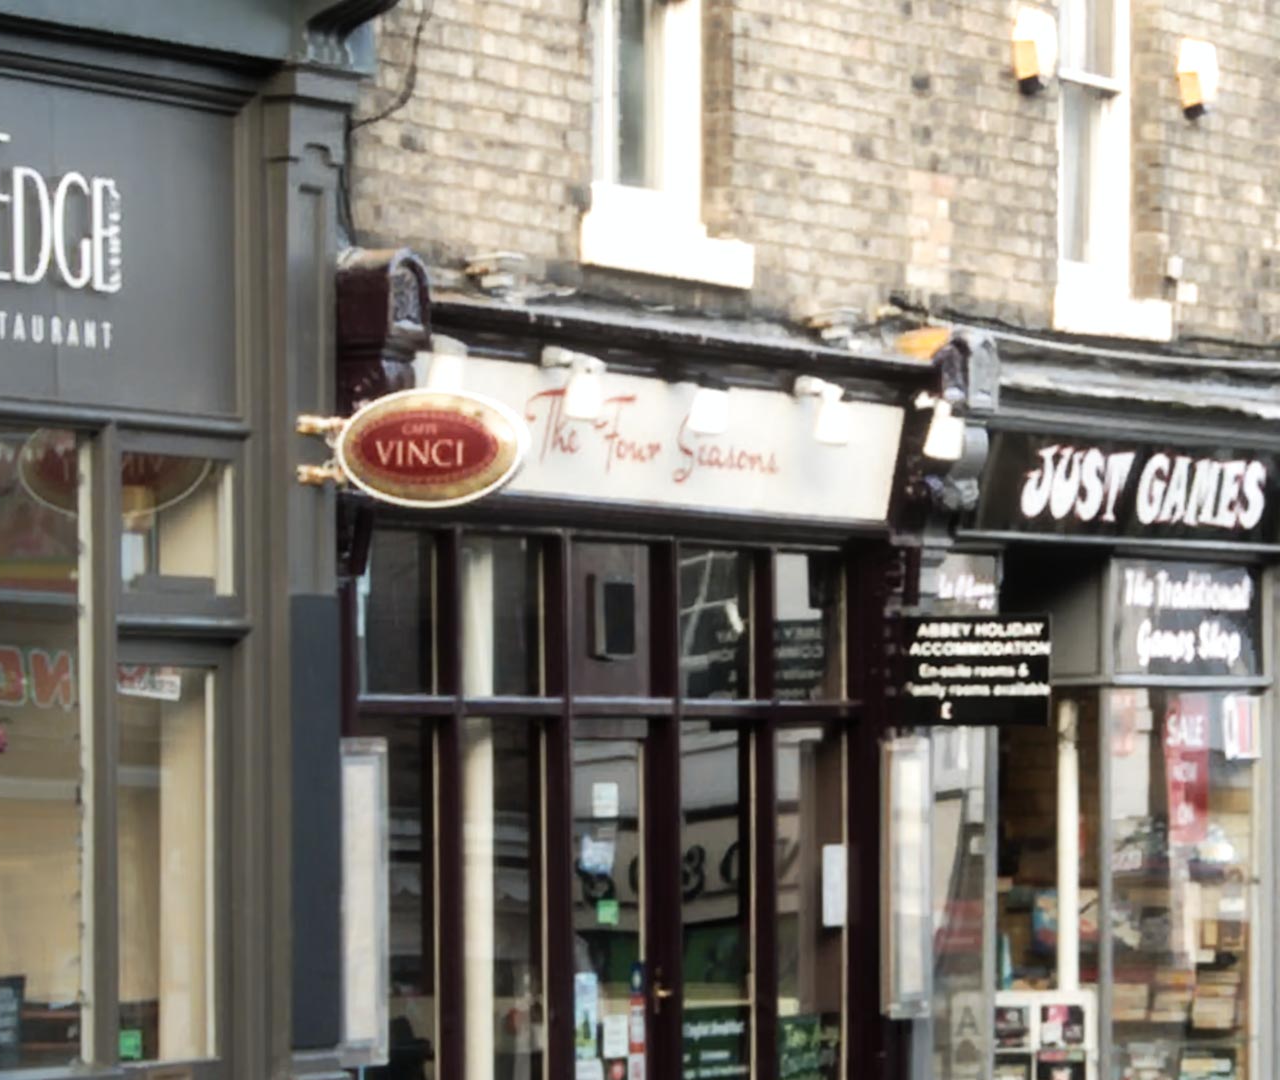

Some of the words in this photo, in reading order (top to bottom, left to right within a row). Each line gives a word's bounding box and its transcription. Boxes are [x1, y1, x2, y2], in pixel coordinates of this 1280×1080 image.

[375, 439, 464, 467] VINCI
[1020, 444, 1136, 522] JUST
[1136, 452, 1267, 530] GAMES
[1124, 567, 1154, 608] The
[1155, 571, 1253, 613] Traditional
[917, 621, 972, 639] ABBEY
[974, 621, 1045, 639] HOLIDAY
[1137, 618, 1195, 667] Games
[1197, 619, 1242, 667] Shop
[909, 640, 1052, 657] ACCOMMODATION
[1166, 714, 1204, 747] SALE
